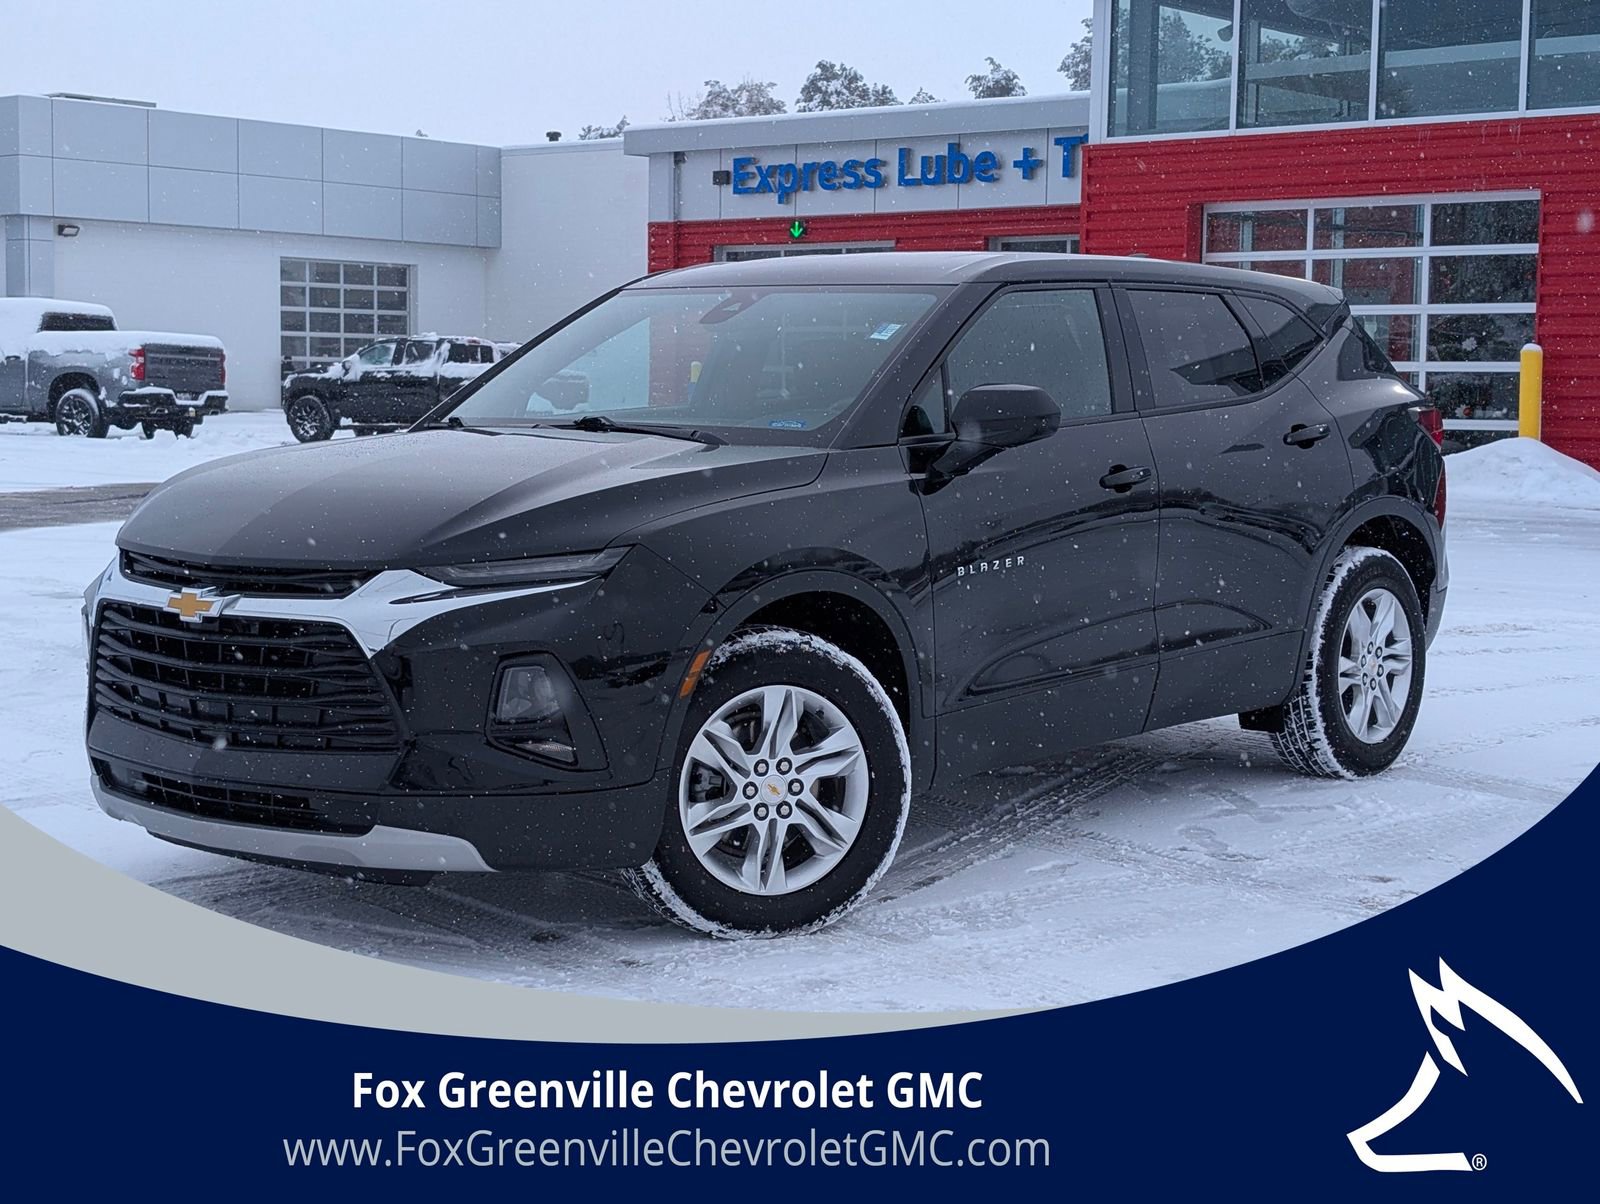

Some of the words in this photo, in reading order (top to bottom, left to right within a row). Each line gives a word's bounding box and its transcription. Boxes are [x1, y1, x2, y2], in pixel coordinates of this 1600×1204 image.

[732, 156, 886, 204] Express
[897, 143, 998, 187] Lube
[1012, 147, 1041, 180] +
[1053, 133, 1088, 178] T
[957, 556, 1024, 577] BLAZER
